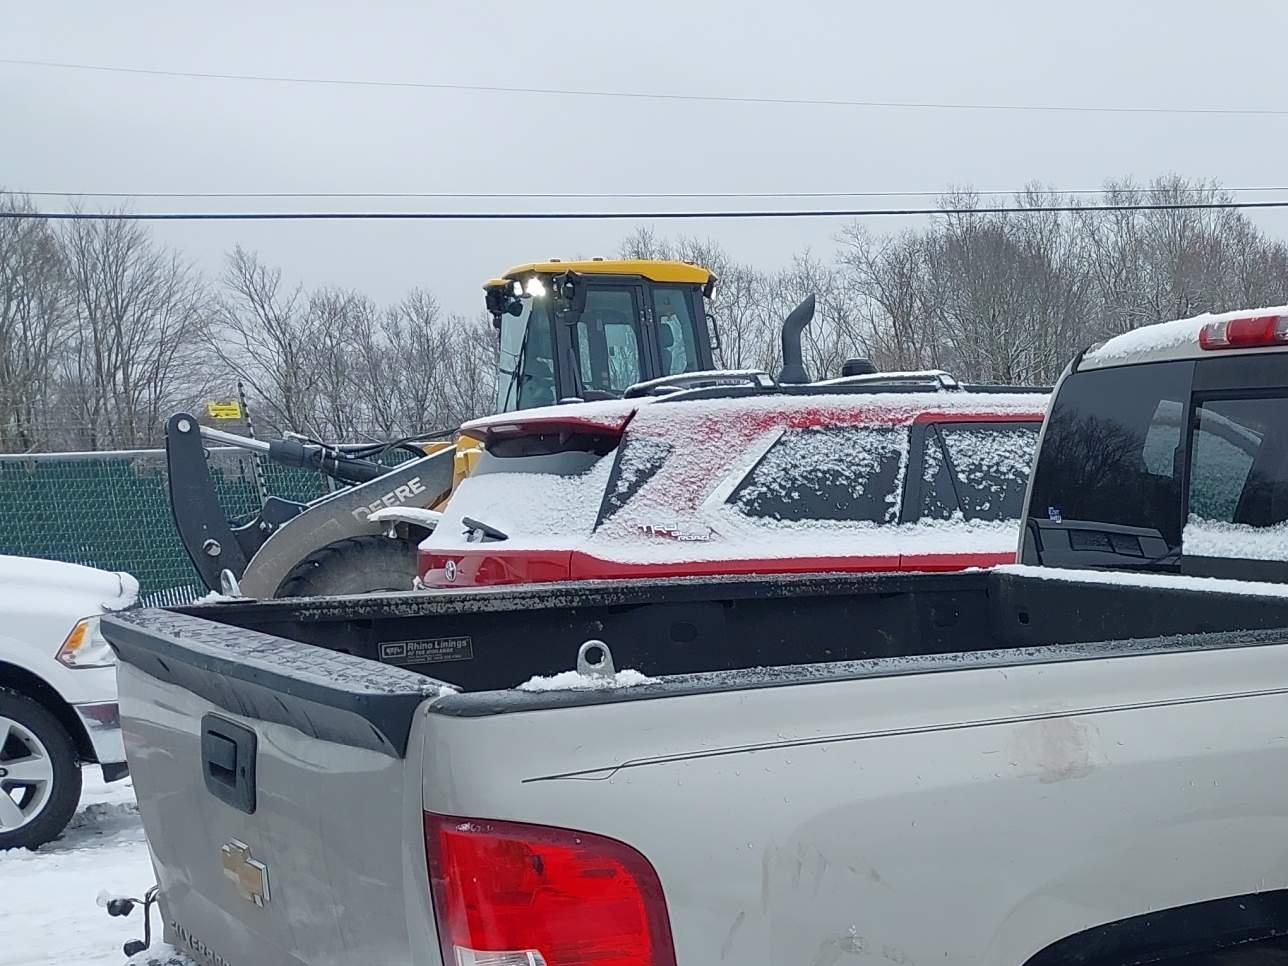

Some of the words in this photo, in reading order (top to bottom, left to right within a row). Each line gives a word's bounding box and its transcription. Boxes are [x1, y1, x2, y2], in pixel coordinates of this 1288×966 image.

[351, 477, 427, 521] DEERE
[407, 642, 433, 652] Rhino
[434, 639, 467, 650] Linings
